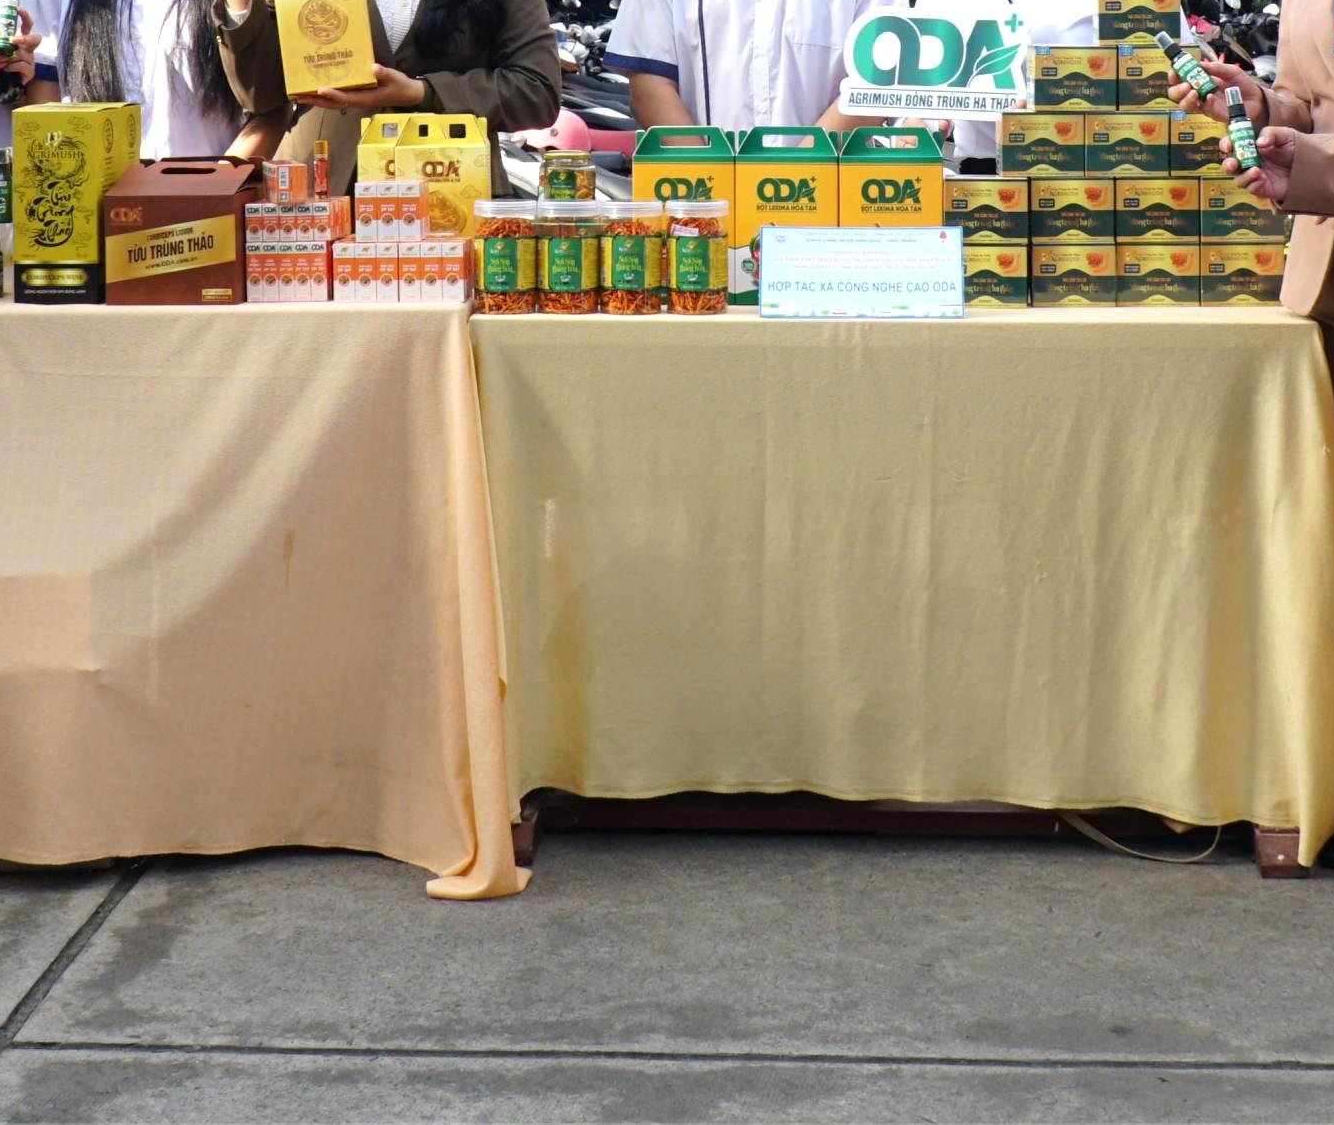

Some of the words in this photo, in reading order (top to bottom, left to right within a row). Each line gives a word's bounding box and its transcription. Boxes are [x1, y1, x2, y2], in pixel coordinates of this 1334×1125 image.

[848, 92, 902, 107] AGRIMUSH
[906, 91, 933, 107] ĐÔNG
[936, 92, 970, 109] TRÙNG
[127, 248, 147, 264] TỬU
[150, 237, 184, 261] TRÙNG
[187, 231, 214, 254] THẢO
[767, 281, 791, 294] HỢP
[795, 280, 816, 292] TÁC
[819, 280, 834, 292] XÃ
[837, 279, 869, 292] CÔNG
[872, 280, 902, 294] NGHỆ
[906, 281, 929, 292] CAO
[932, 281, 957, 292] ODA
